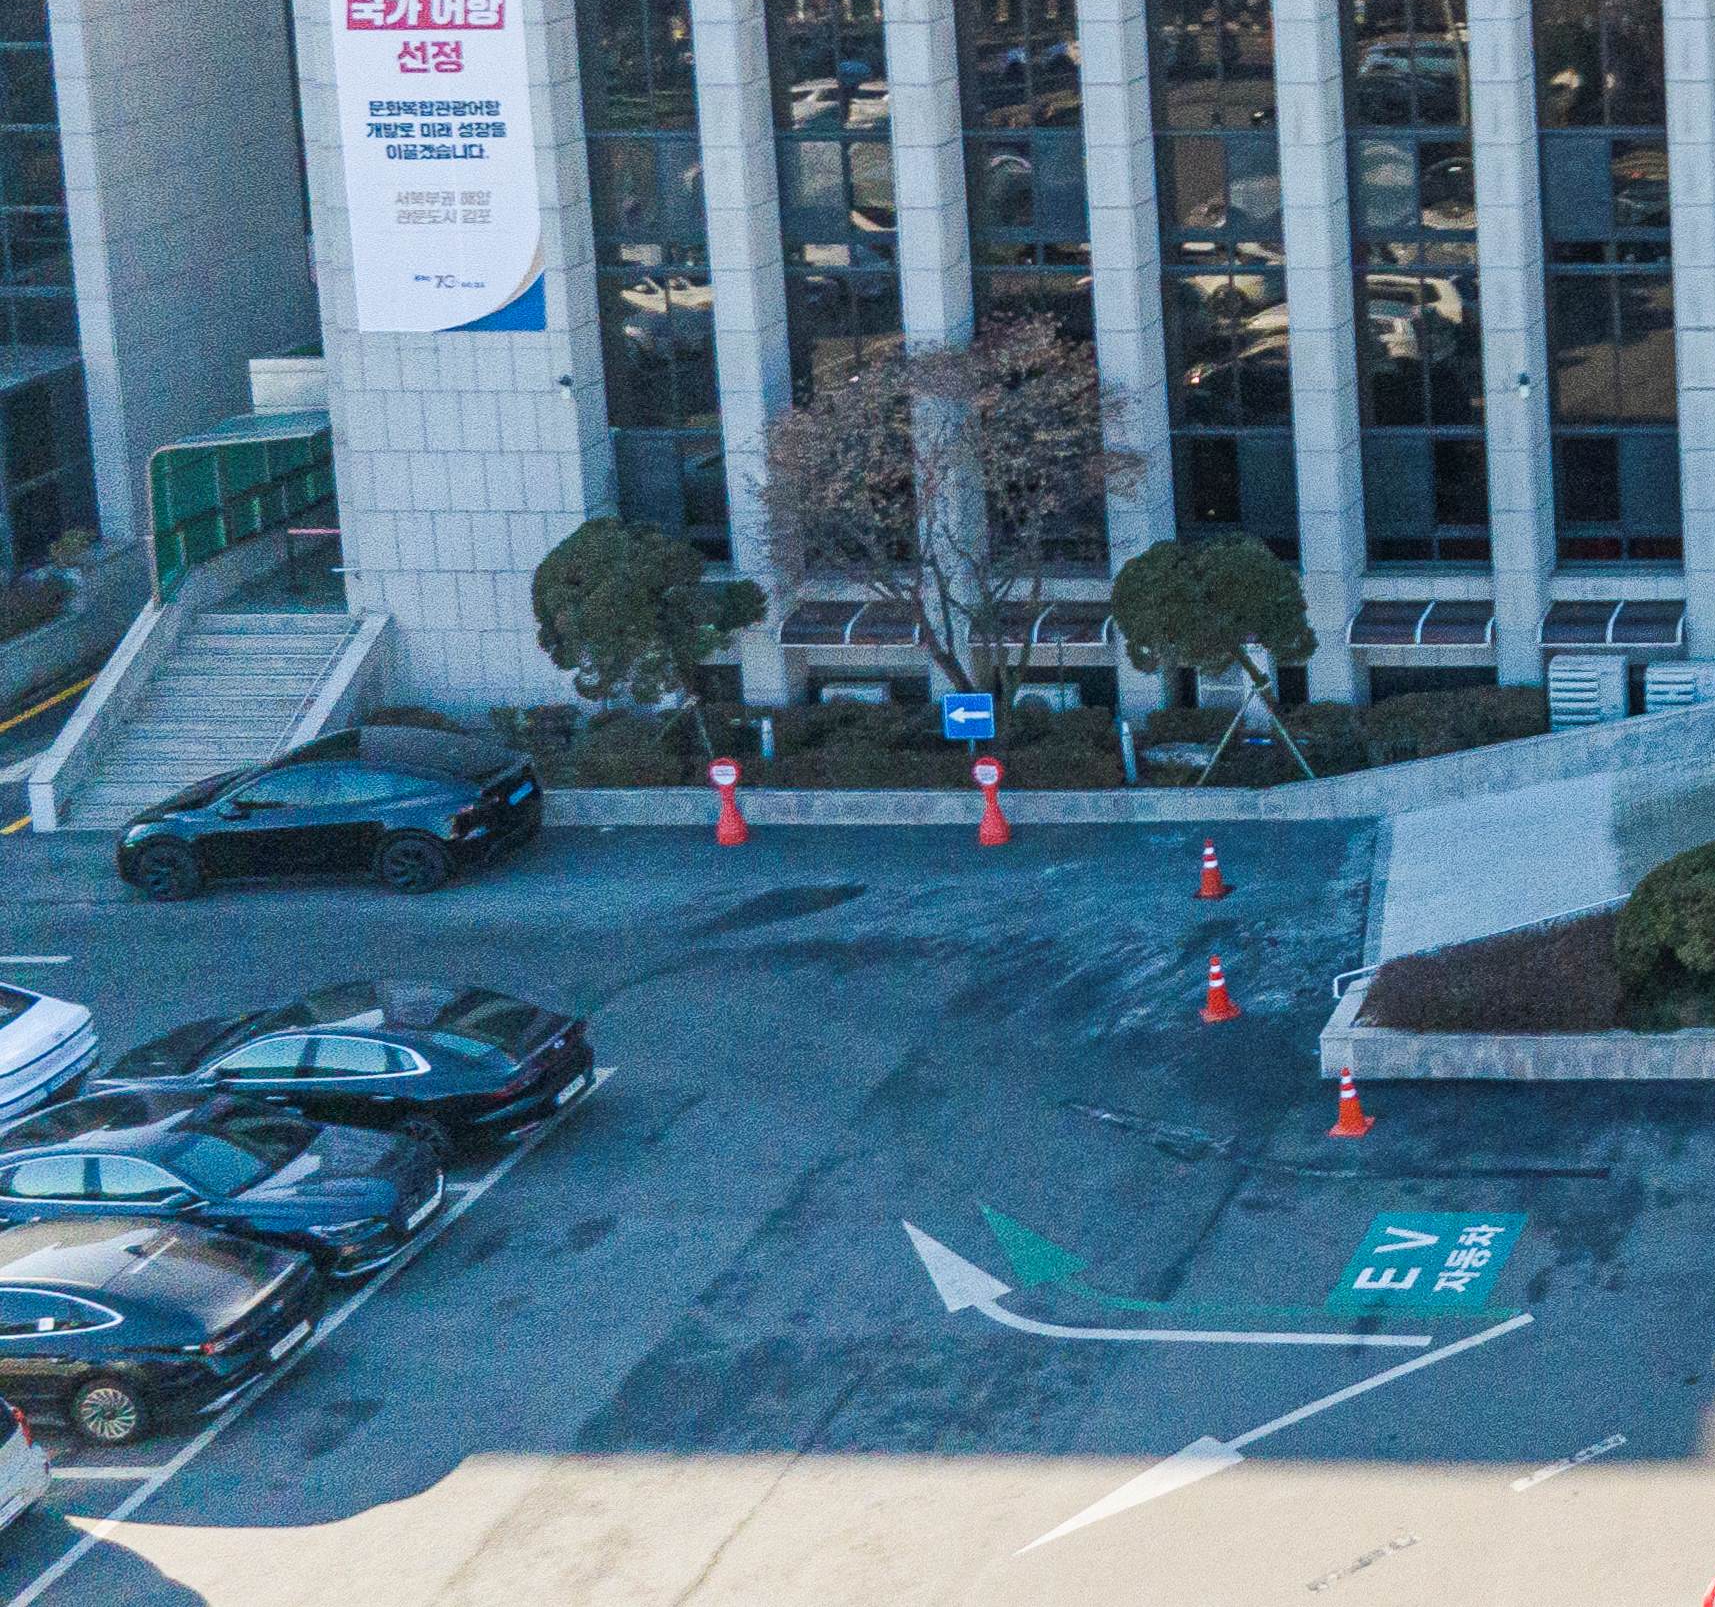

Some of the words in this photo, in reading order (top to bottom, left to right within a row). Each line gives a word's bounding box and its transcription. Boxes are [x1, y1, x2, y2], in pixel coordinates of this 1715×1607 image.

[398, 40, 464, 74] 선정
[369, 100, 501, 117] 문화복합관광어항
[366, 122, 415, 139] 개발로
[421, 122, 453, 138] 미래
[458, 121, 507, 138] 성장을
[1352, 1226, 1440, 1290] EV
[1432, 1224, 1505, 1293] 자동차
